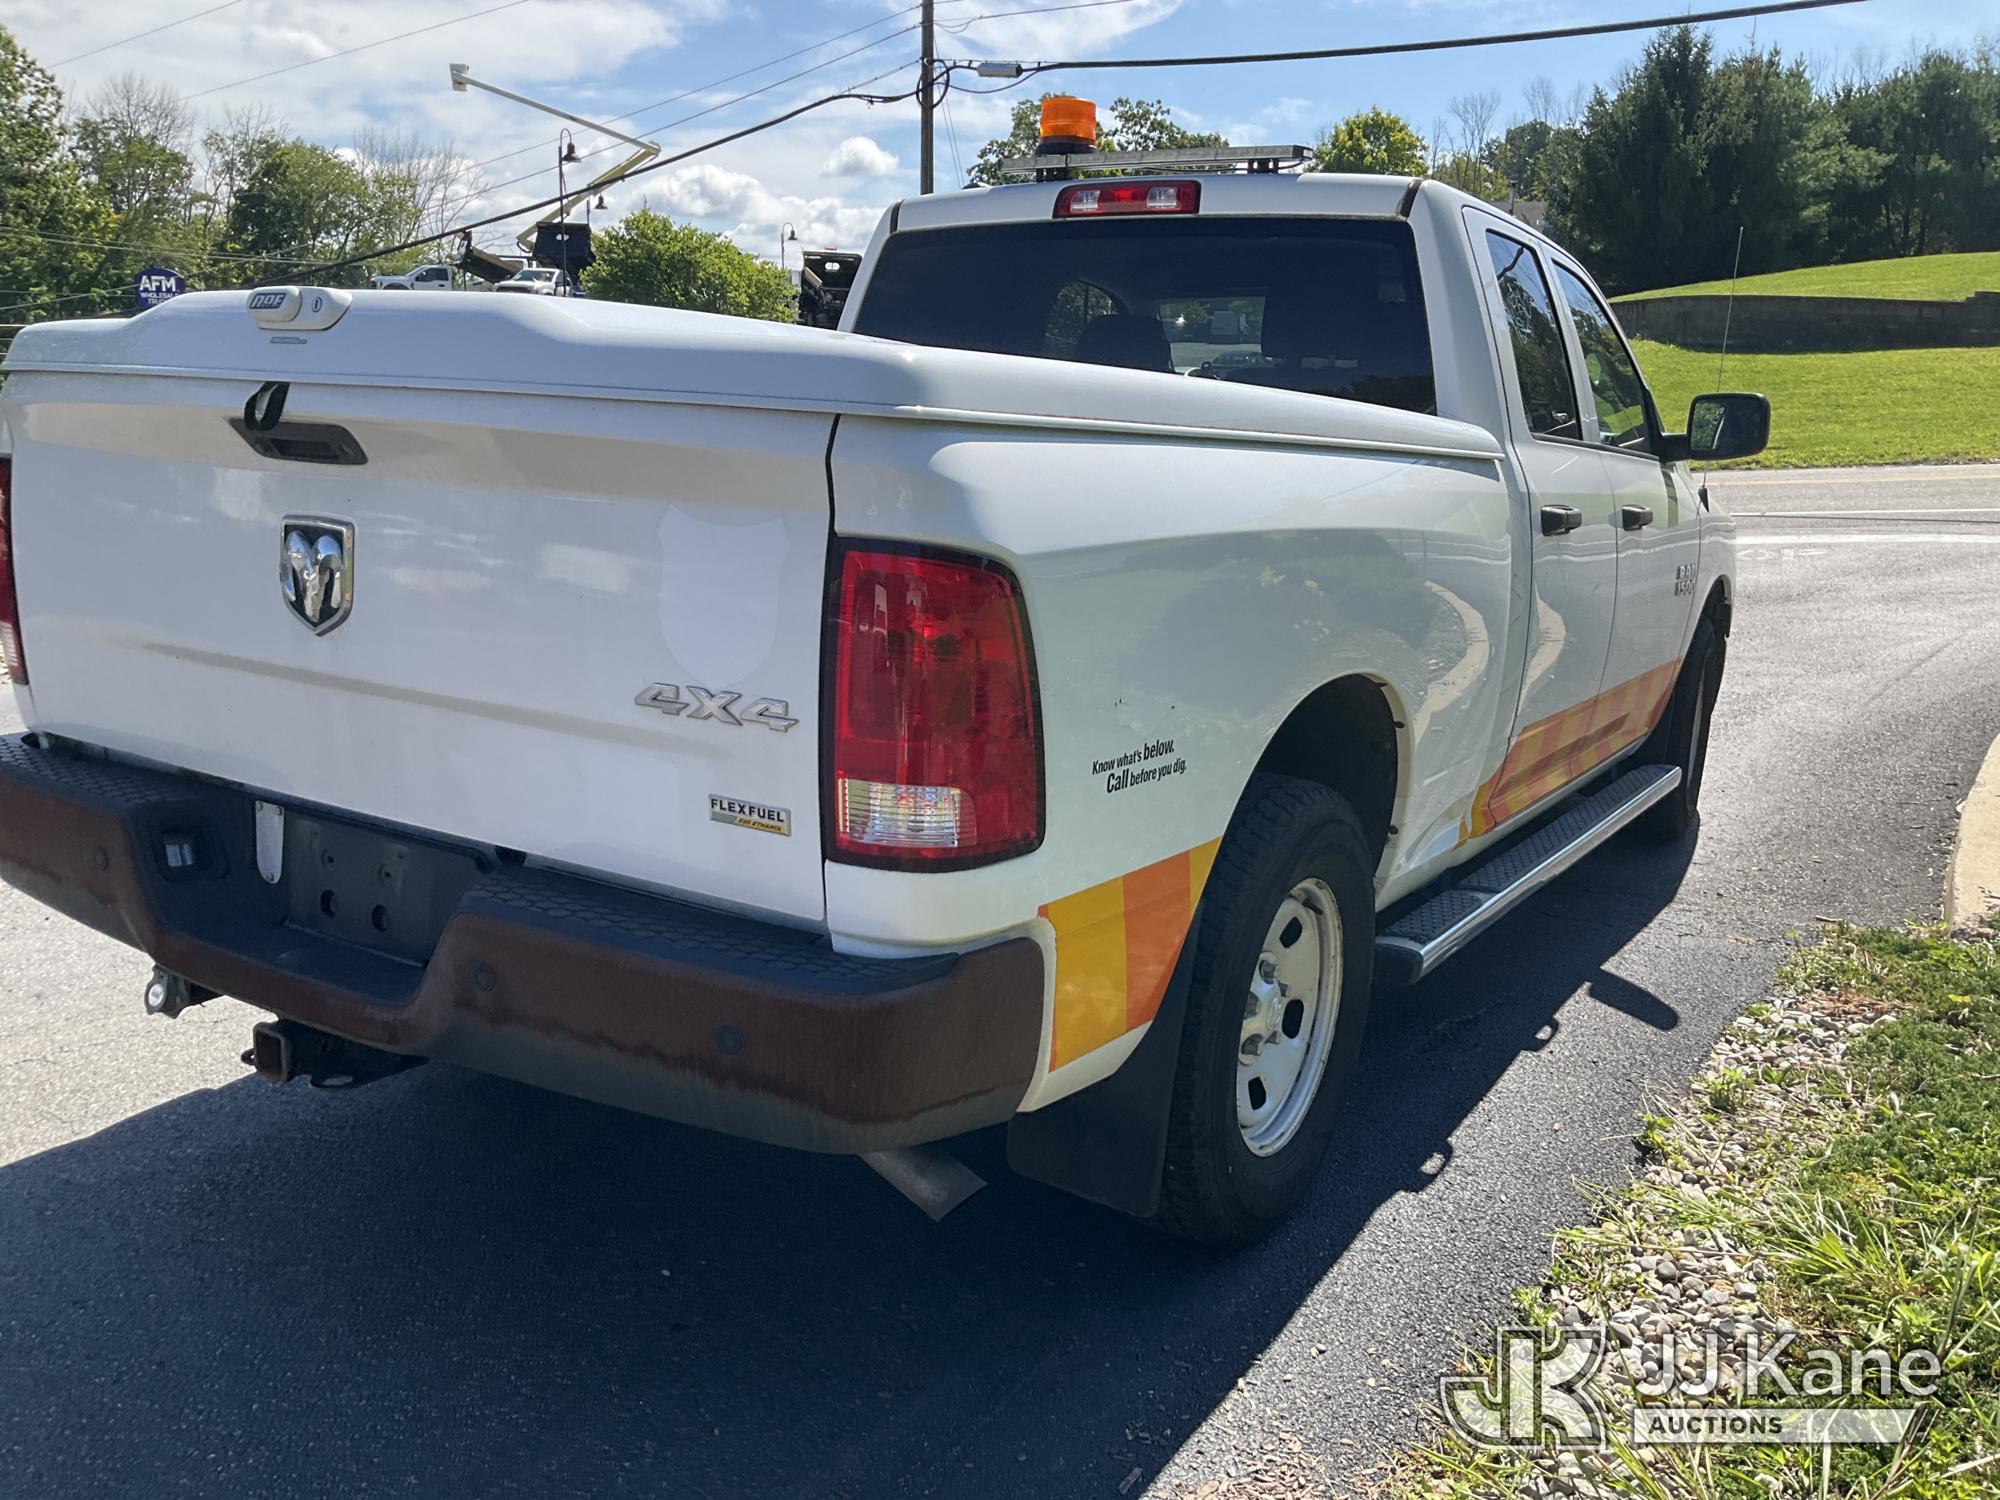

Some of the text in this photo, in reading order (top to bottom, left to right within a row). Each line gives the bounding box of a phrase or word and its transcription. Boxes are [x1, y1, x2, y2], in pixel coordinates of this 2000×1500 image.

[139, 275, 176, 292] AFM
[1092, 739, 1174, 775] Know what's below.
[1107, 757, 1187, 793] Call before you dig.
[711, 798, 784, 823] FLEXFUEL
